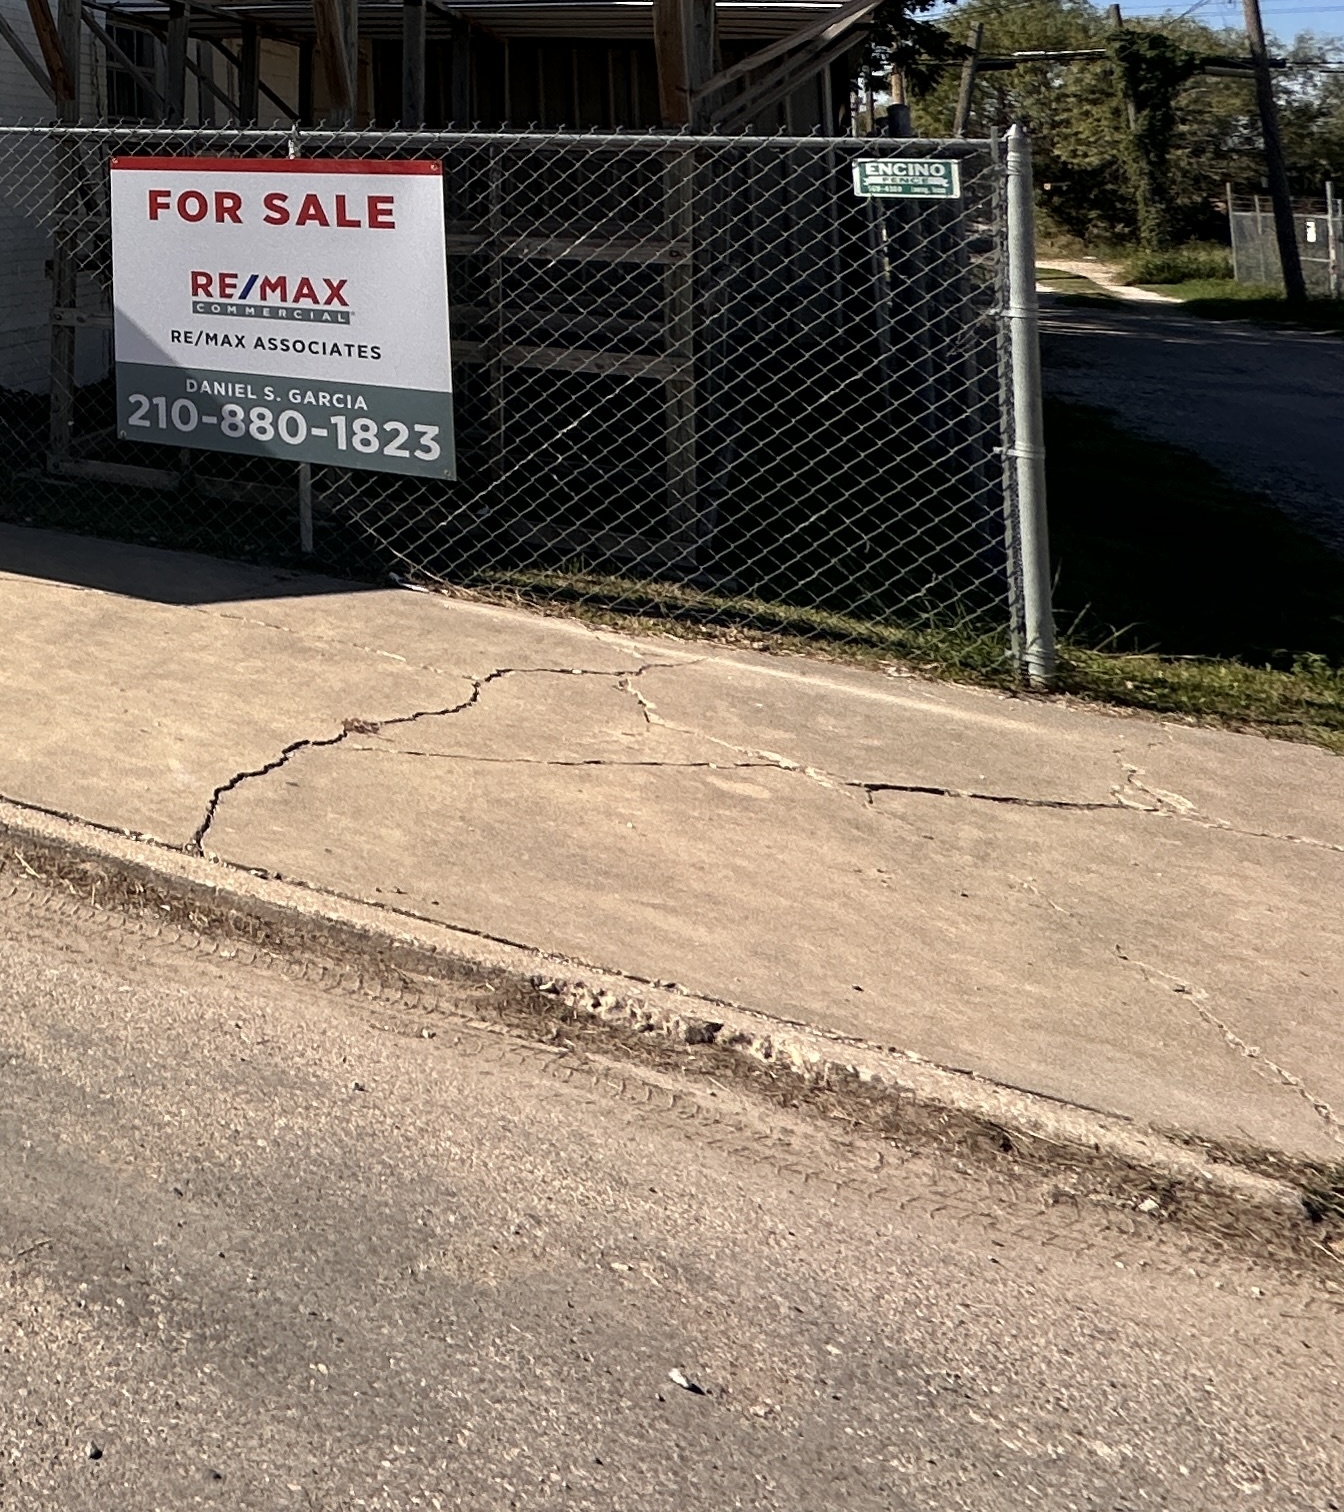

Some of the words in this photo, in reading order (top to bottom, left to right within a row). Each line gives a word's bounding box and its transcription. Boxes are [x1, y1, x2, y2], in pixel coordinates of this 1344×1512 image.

[865, 162, 946, 177] ENCINO
[148, 190, 244, 224] FOR
[262, 193, 396, 229] SALE
[190, 270, 350, 307] RE/MAX
[196, 302, 347, 323] COMMERCIAL
[171, 330, 246, 349] RE/MAX
[254, 336, 382, 360] ASSOCIATES
[185, 378, 257, 400] DANIEL
[263, 387, 281, 402] S.
[288, 389, 368, 411] GARCIA
[128, 394, 442, 461] 210-880-1823
